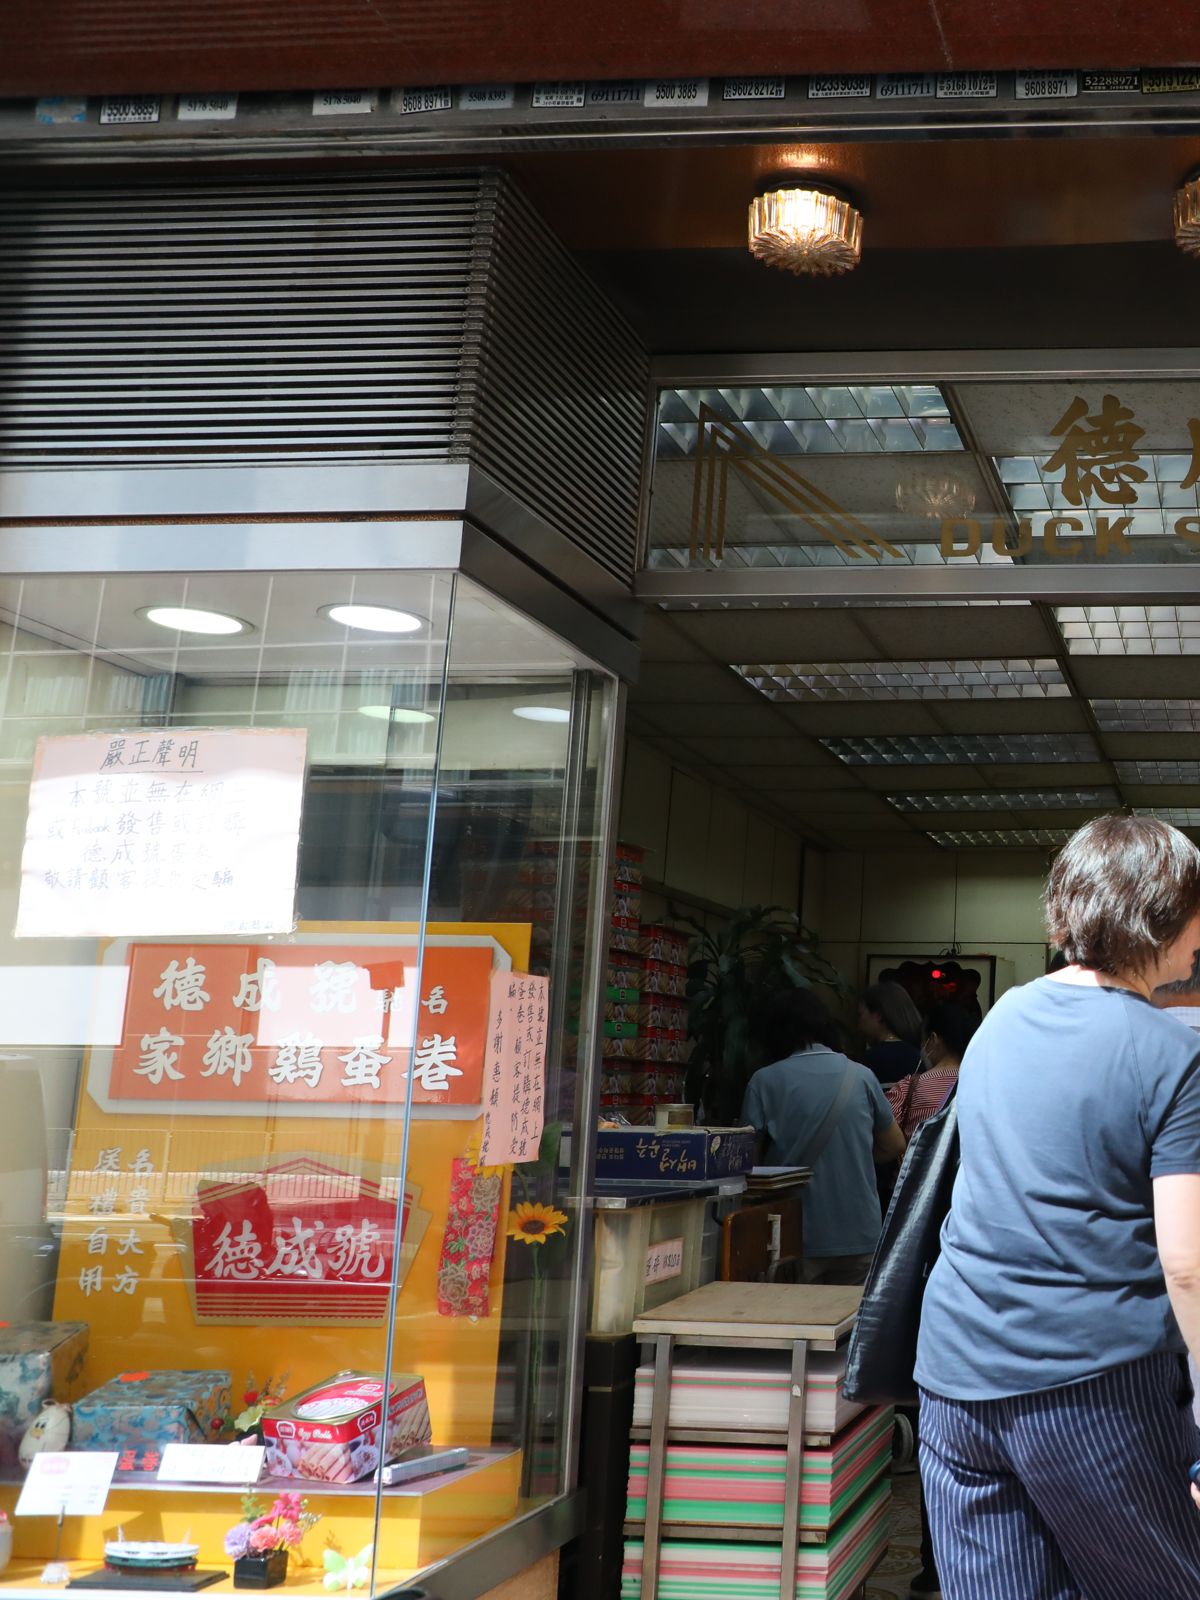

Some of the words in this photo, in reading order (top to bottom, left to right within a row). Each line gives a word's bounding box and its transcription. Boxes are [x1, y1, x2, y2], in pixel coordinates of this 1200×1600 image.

[732, 82, 752, 96] 9602
[754, 81, 775, 95] 8212
[880, 82, 930, 96] 69111711
[968, 79, 988, 91] 1012
[1024, 82, 1046, 96] 9608
[1047, 80, 1069, 95] 8971
[1085, 76, 1138, 86] 52288971
[591, 88, 640, 101] 69111711
[655, 84, 676, 100] 5500
[677, 83, 698, 99] 3885
[403, 95, 422, 112] 9608
[424, 93, 443, 109] 8971
[940, 515, 1136, 558] DUCK
[100, 739, 200, 770] 嚴正聲明
[204, 1216, 387, 1281] 德成號
